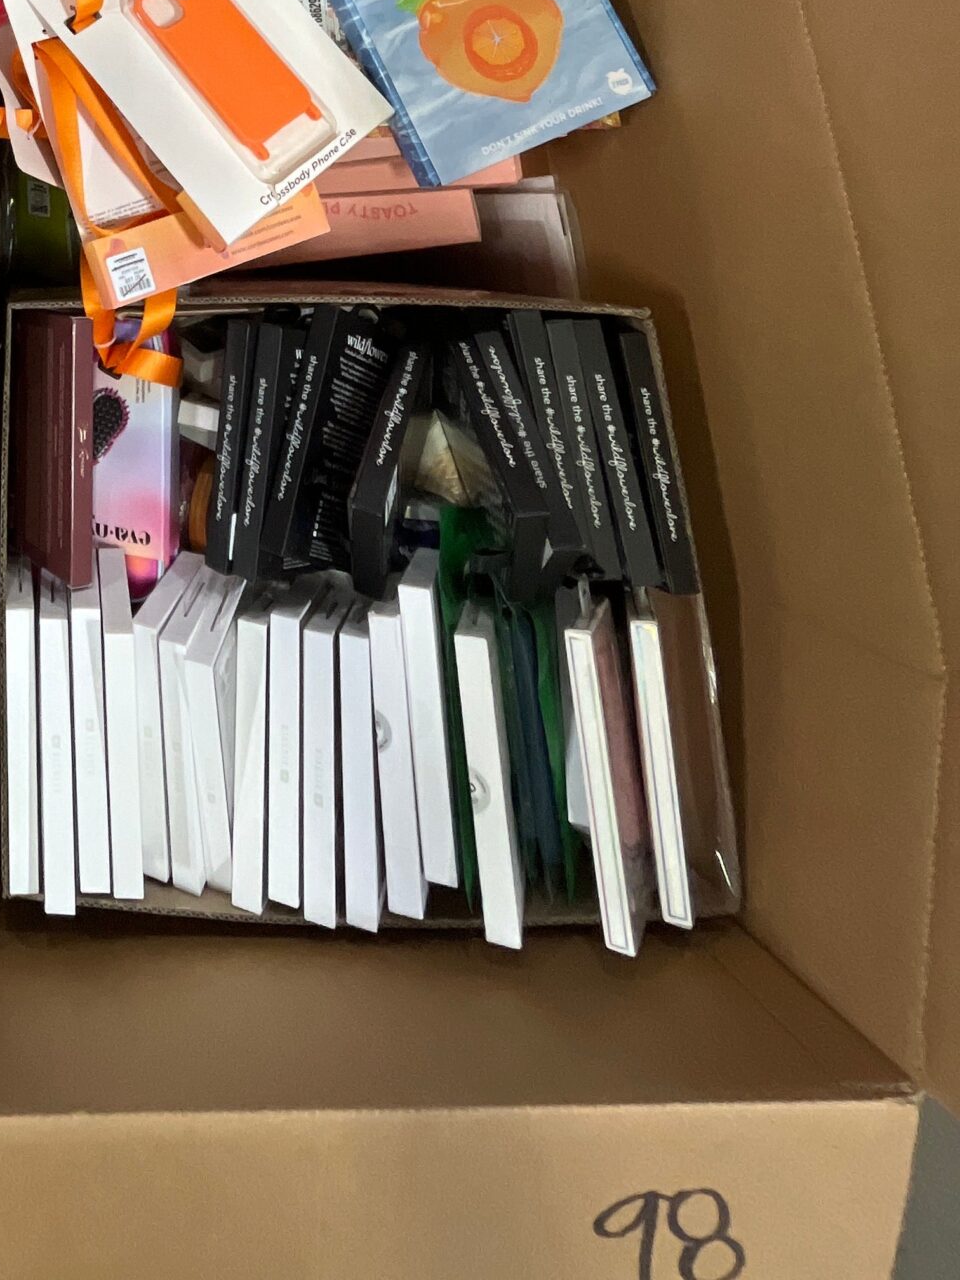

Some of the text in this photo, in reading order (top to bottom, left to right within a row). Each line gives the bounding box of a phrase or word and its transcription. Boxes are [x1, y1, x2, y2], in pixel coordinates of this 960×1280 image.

[310, 145, 340, 172] Phone
[346, 202, 419, 220] TOASTY
[305, 355, 319, 382] share
[405, 351, 418, 372] share
[458, 342, 474, 364] share
[469, 365, 480, 380] the
[227, 374, 238, 402] share
[257, 378, 268, 406] share
[300, 384, 312, 401] the
[400, 373, 412, 386] the
[534, 357, 547, 385] share
[541, 388, 552, 405] the
[566, 375, 578, 403] share
[572, 405, 583, 422] the
[595, 374, 607, 402] share
[602, 404, 613, 421] the
[640, 387, 653, 416] share
[647, 418, 658, 435] the
[226, 404, 235, 421] the
[255, 408, 265, 425] the
[523, 440, 536, 458] the
[530, 460, 547, 489] share
[593, 1188, 746, 1280] 98
